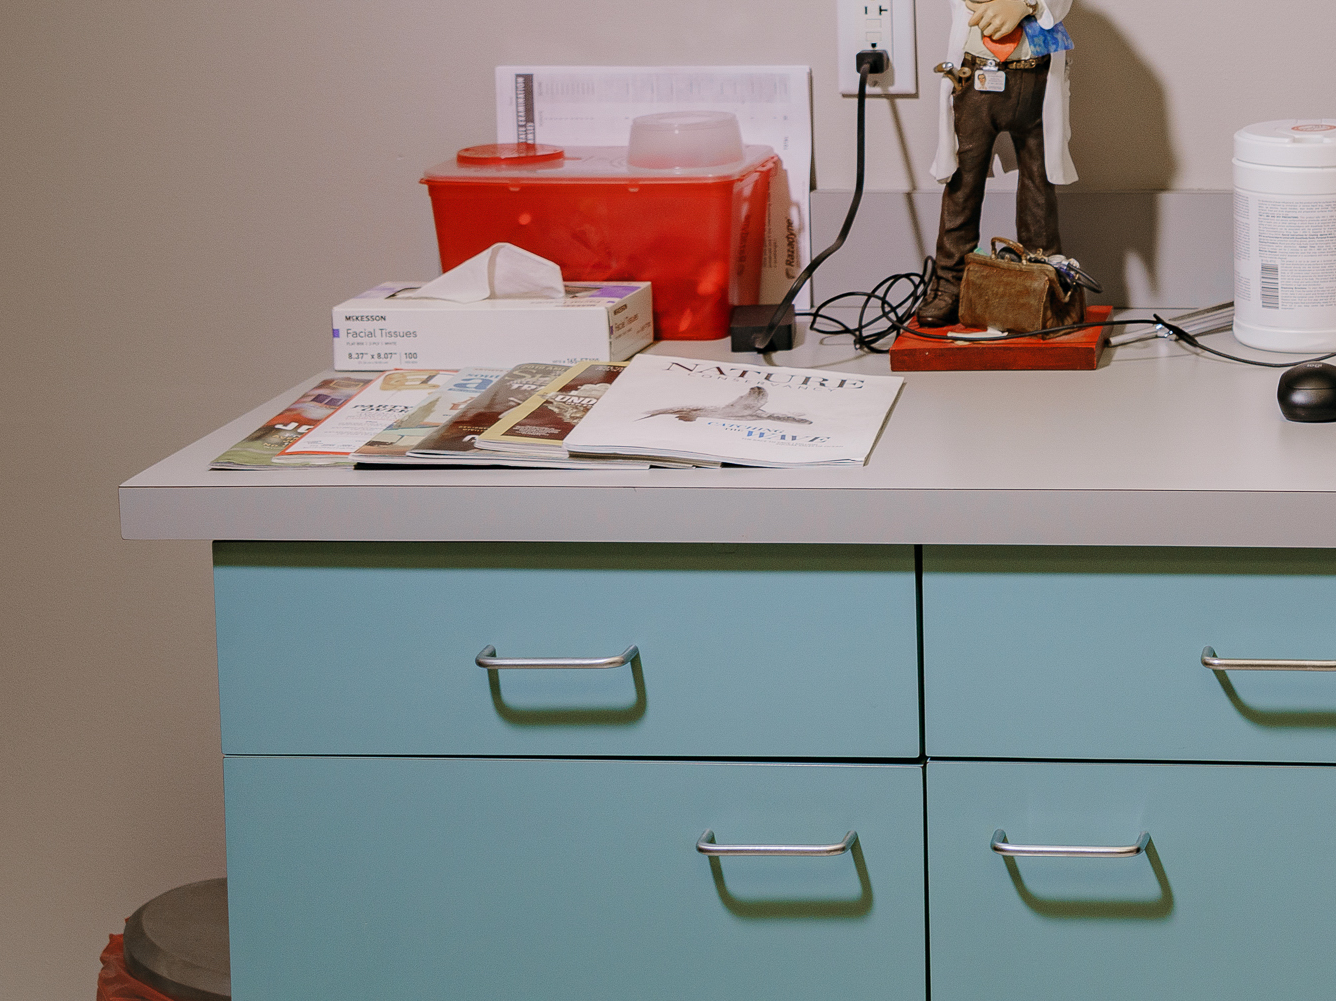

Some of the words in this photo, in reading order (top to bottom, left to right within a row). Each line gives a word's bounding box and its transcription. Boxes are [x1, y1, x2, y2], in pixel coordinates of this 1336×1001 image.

[516, 76, 526, 126] EXAMINATION
[518, 127, 527, 144] TATE
[785, 218, 797, 267] Razadyne
[346, 328, 377, 339] Facial
[379, 328, 418, 339] Tissues
[404, 352, 418, 360] 100
[664, 362, 866, 390] NATURE
[687, 373, 837, 392] CONSERVANCY
[554, 394, 598, 406] UND
[708, 421, 785, 434] CATCHING
[746, 430, 831, 443] WAVE
